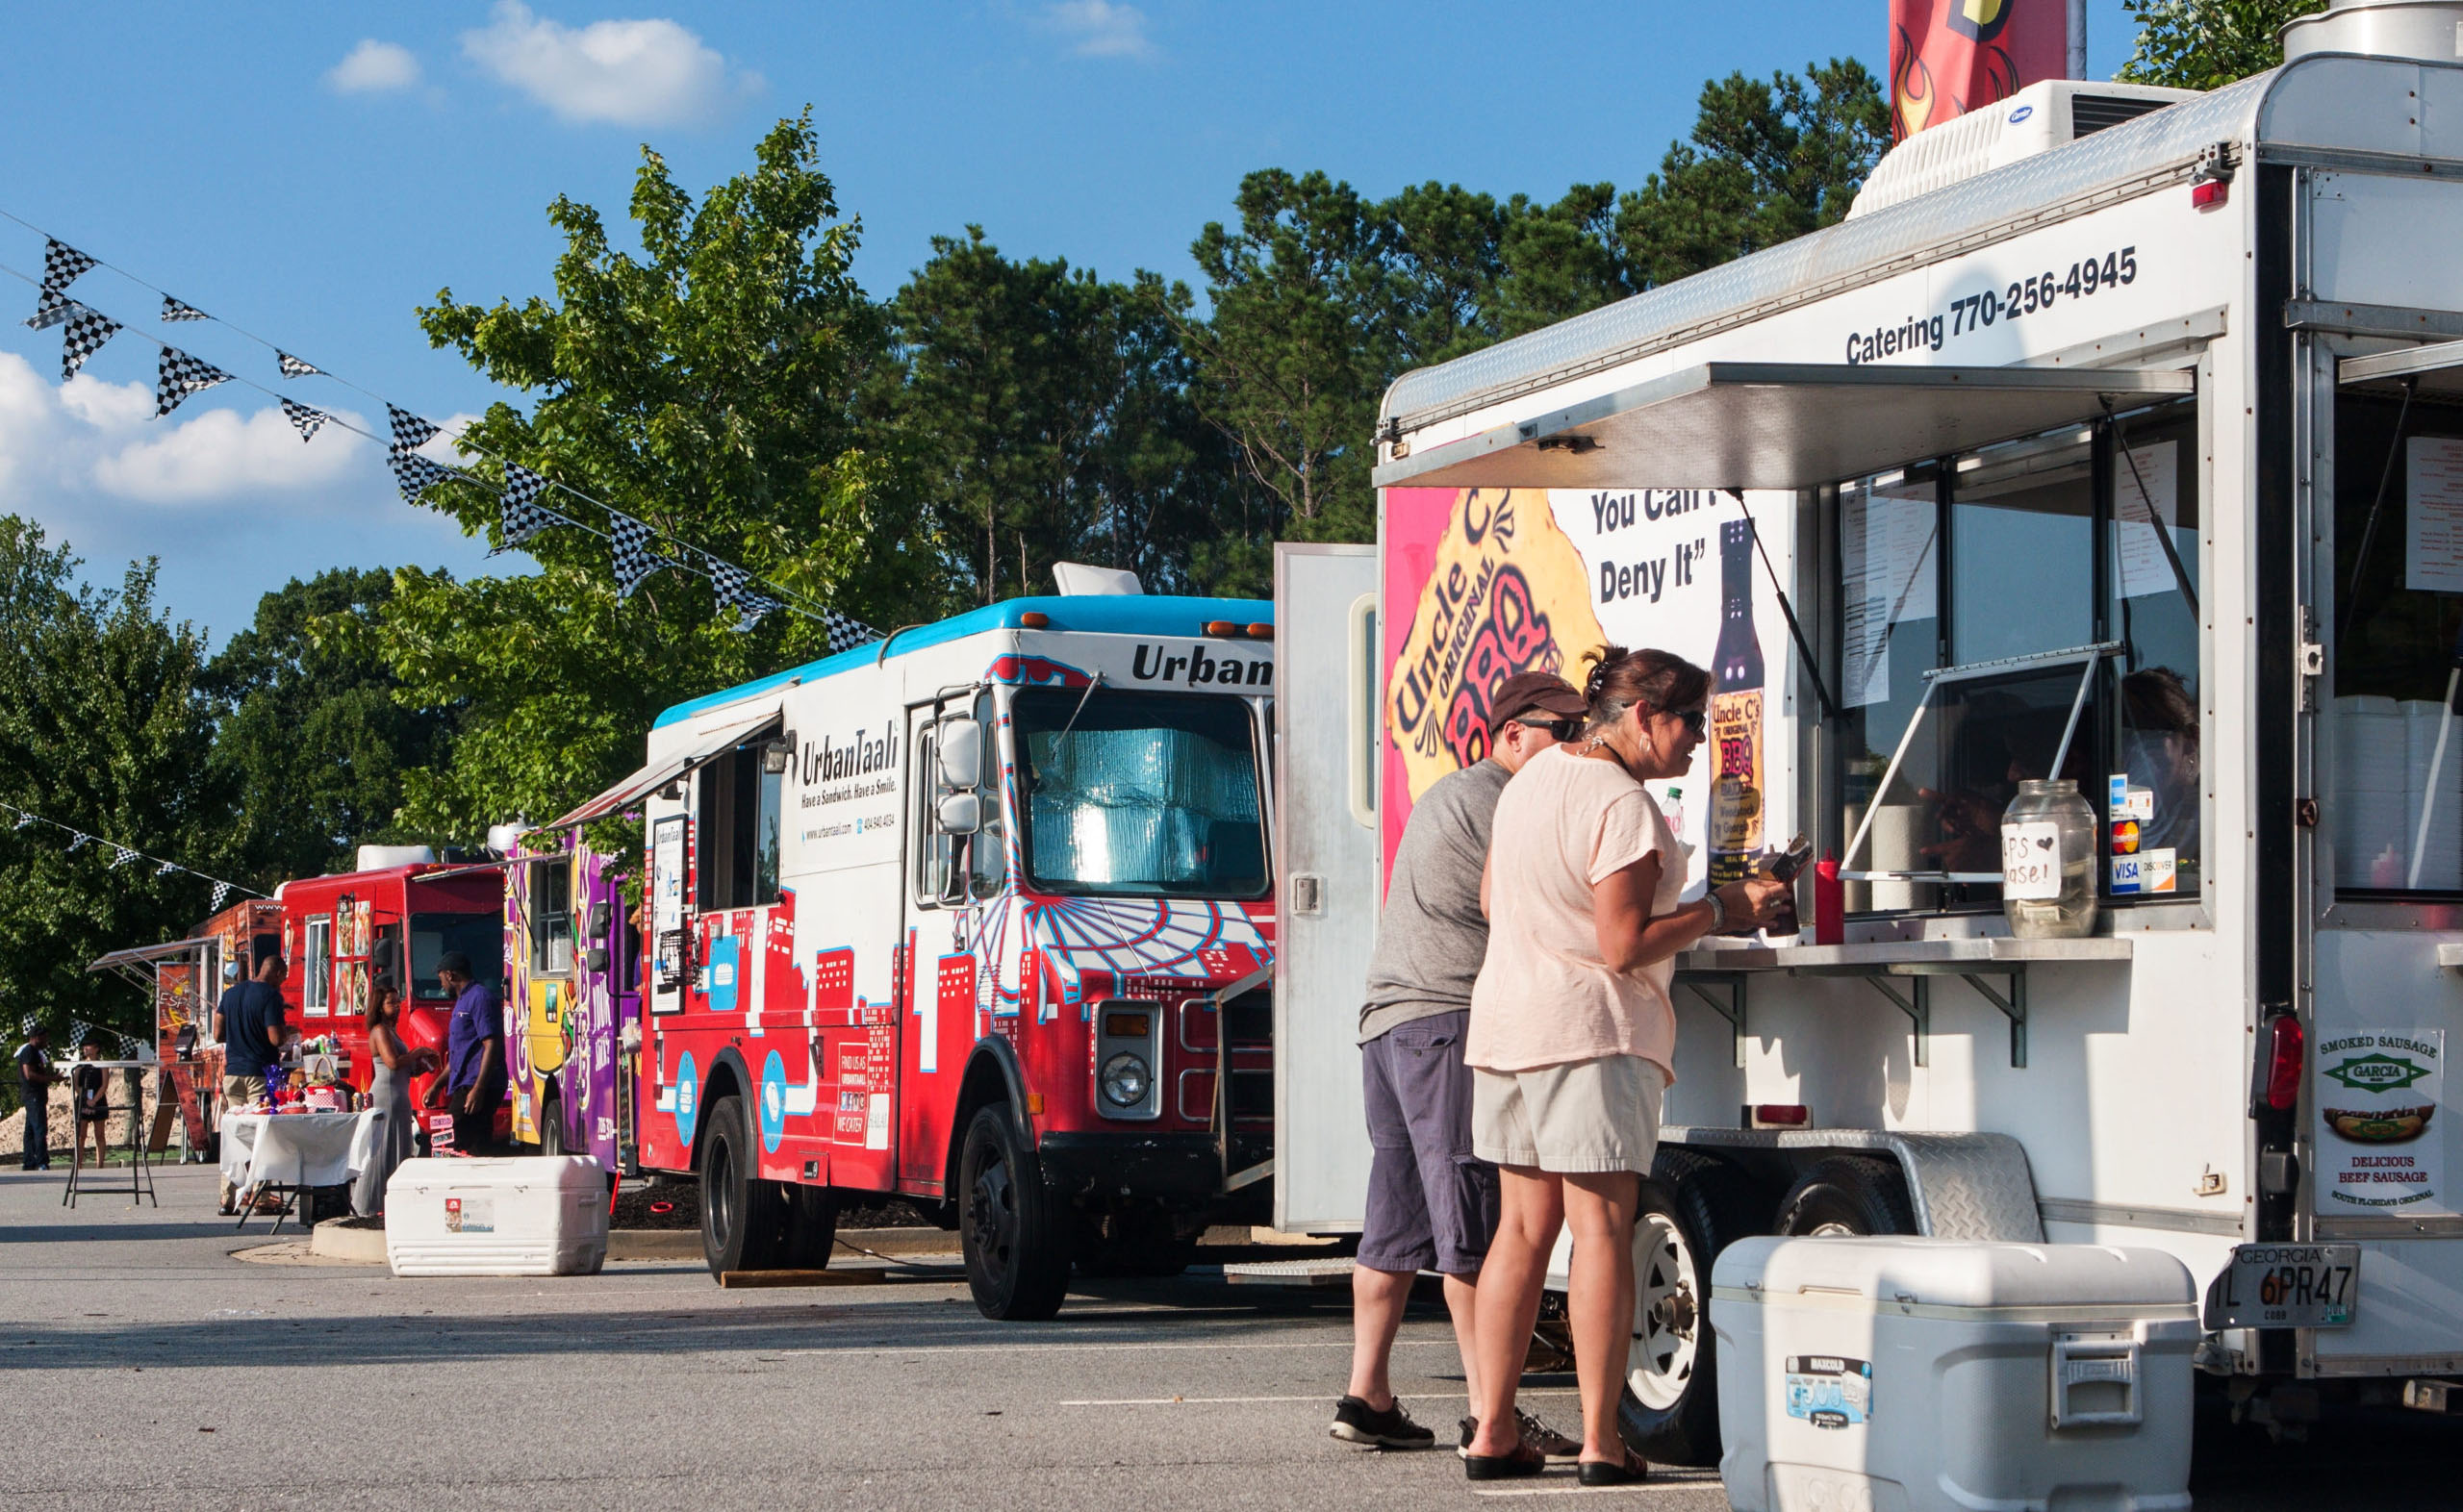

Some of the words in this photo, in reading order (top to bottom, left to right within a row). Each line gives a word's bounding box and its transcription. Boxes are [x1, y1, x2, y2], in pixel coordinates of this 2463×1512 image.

[1847, 314, 1943, 365] Catering
[1950, 245, 2137, 338] 770-256-4945
[1590, 491, 1635, 535] You
[1601, 558, 1666, 604] Deny
[1438, 554, 1495, 699] ORIGINAL
[1396, 560, 1467, 734] Uncle
[1444, 564, 1550, 769] BBQ
[1714, 702, 1742, 723] Uncle
[1744, 698, 1760, 720] C's
[802, 718, 899, 786] UrbanTaali
[1720, 734, 1754, 780] BBQ
[801, 793, 816, 808] Have
[853, 781, 870, 799] Have
[2116, 862, 2139, 879] VISA
[2144, 860, 2171, 871] DISCOVER
[2320, 1036, 2374, 1054] SMOKED
[2378, 1036, 2438, 1059] SAUSAGE
[2353, 1065, 2401, 1077] GARCIA
[837, 1117, 846, 1132] WE
[846, 1117, 863, 1133] CATER
[2351, 1156, 2415, 1168] DELICIOUS
[2339, 1172, 2371, 1183] BEEF
[2373, 1172, 2427, 1183] SAUSAGE
[2331, 1190, 2357, 1205] SOUTH
[2358, 1197, 2398, 1206] FLORIDA'S
[2399, 1190, 2434, 1205] ORIGINAL
[2240, 1248, 2322, 1264] GEORGIA
[2261, 1267, 2352, 1306] 6PR47
[2265, 1311, 2287, 1321] COBB
